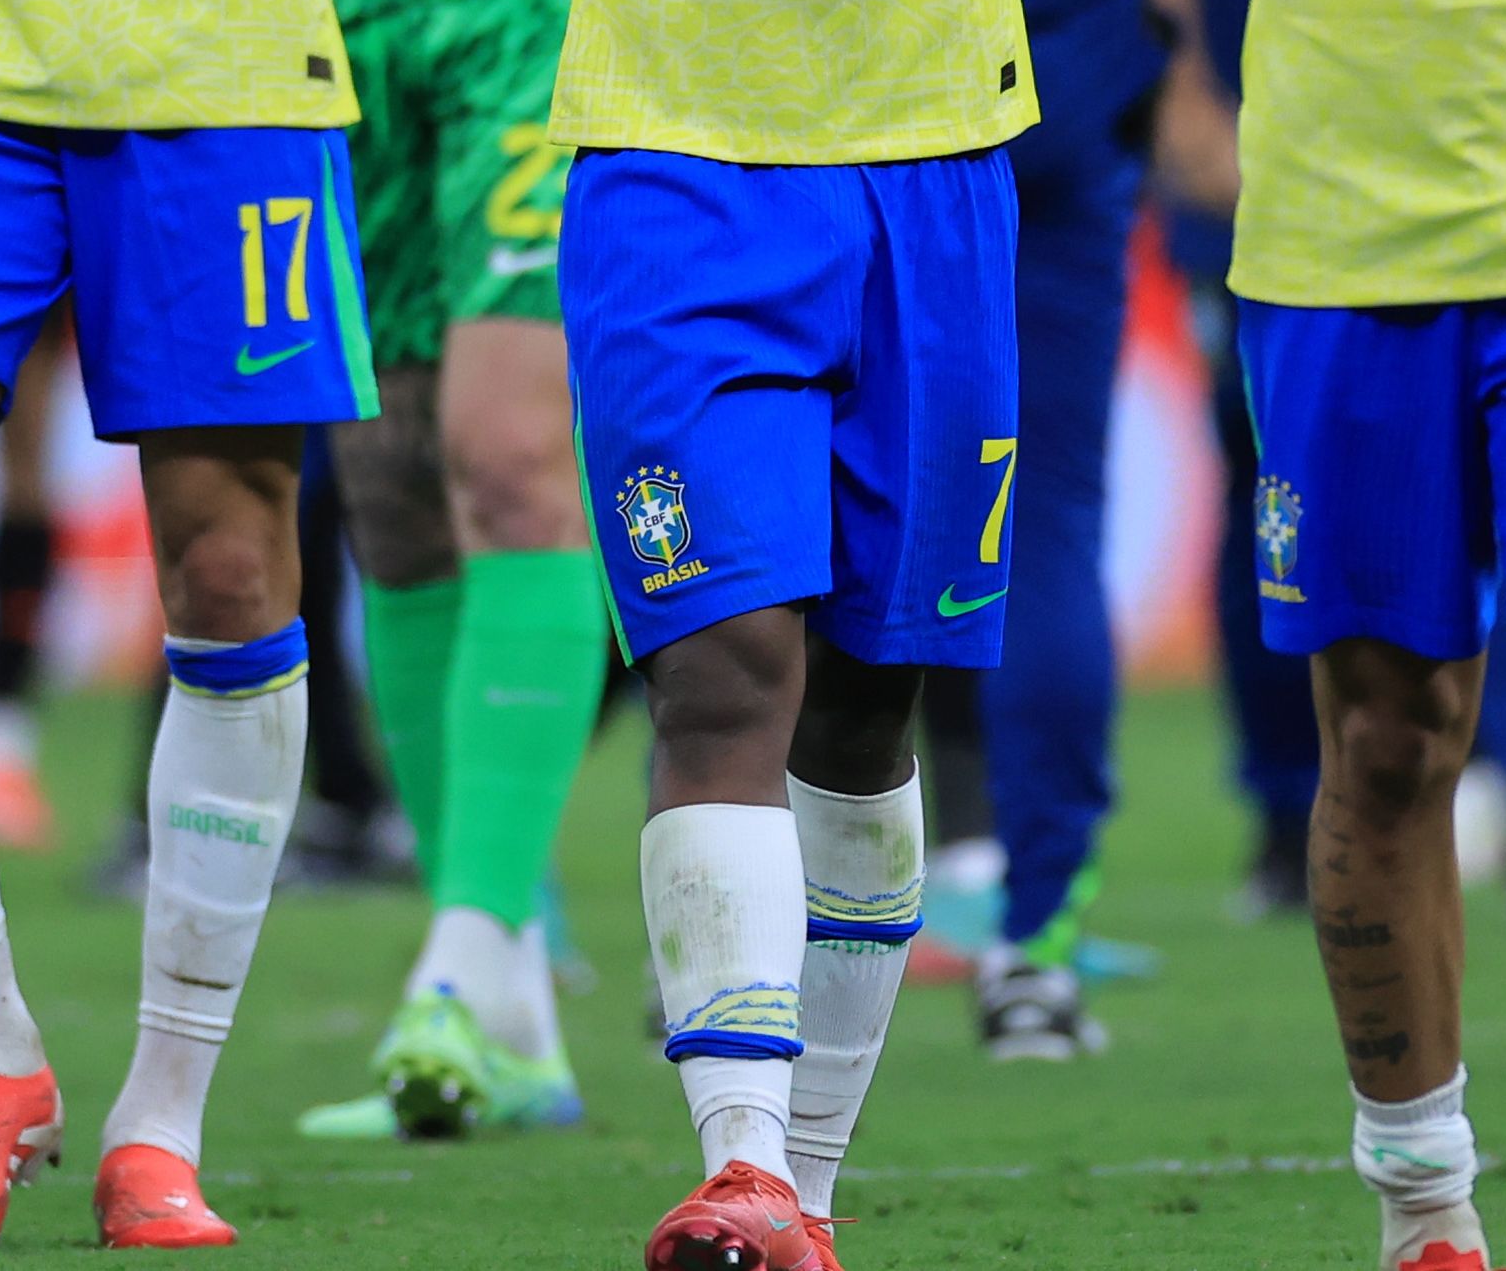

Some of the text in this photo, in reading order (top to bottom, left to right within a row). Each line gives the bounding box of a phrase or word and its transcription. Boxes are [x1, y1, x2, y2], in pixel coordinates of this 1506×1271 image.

[238, 197, 313, 327] 17
[644, 512, 667, 528] CBF
[979, 438, 1017, 563] 7
[642, 559, 710, 594] BRASIL
[169, 804, 269, 847] BRASIL
